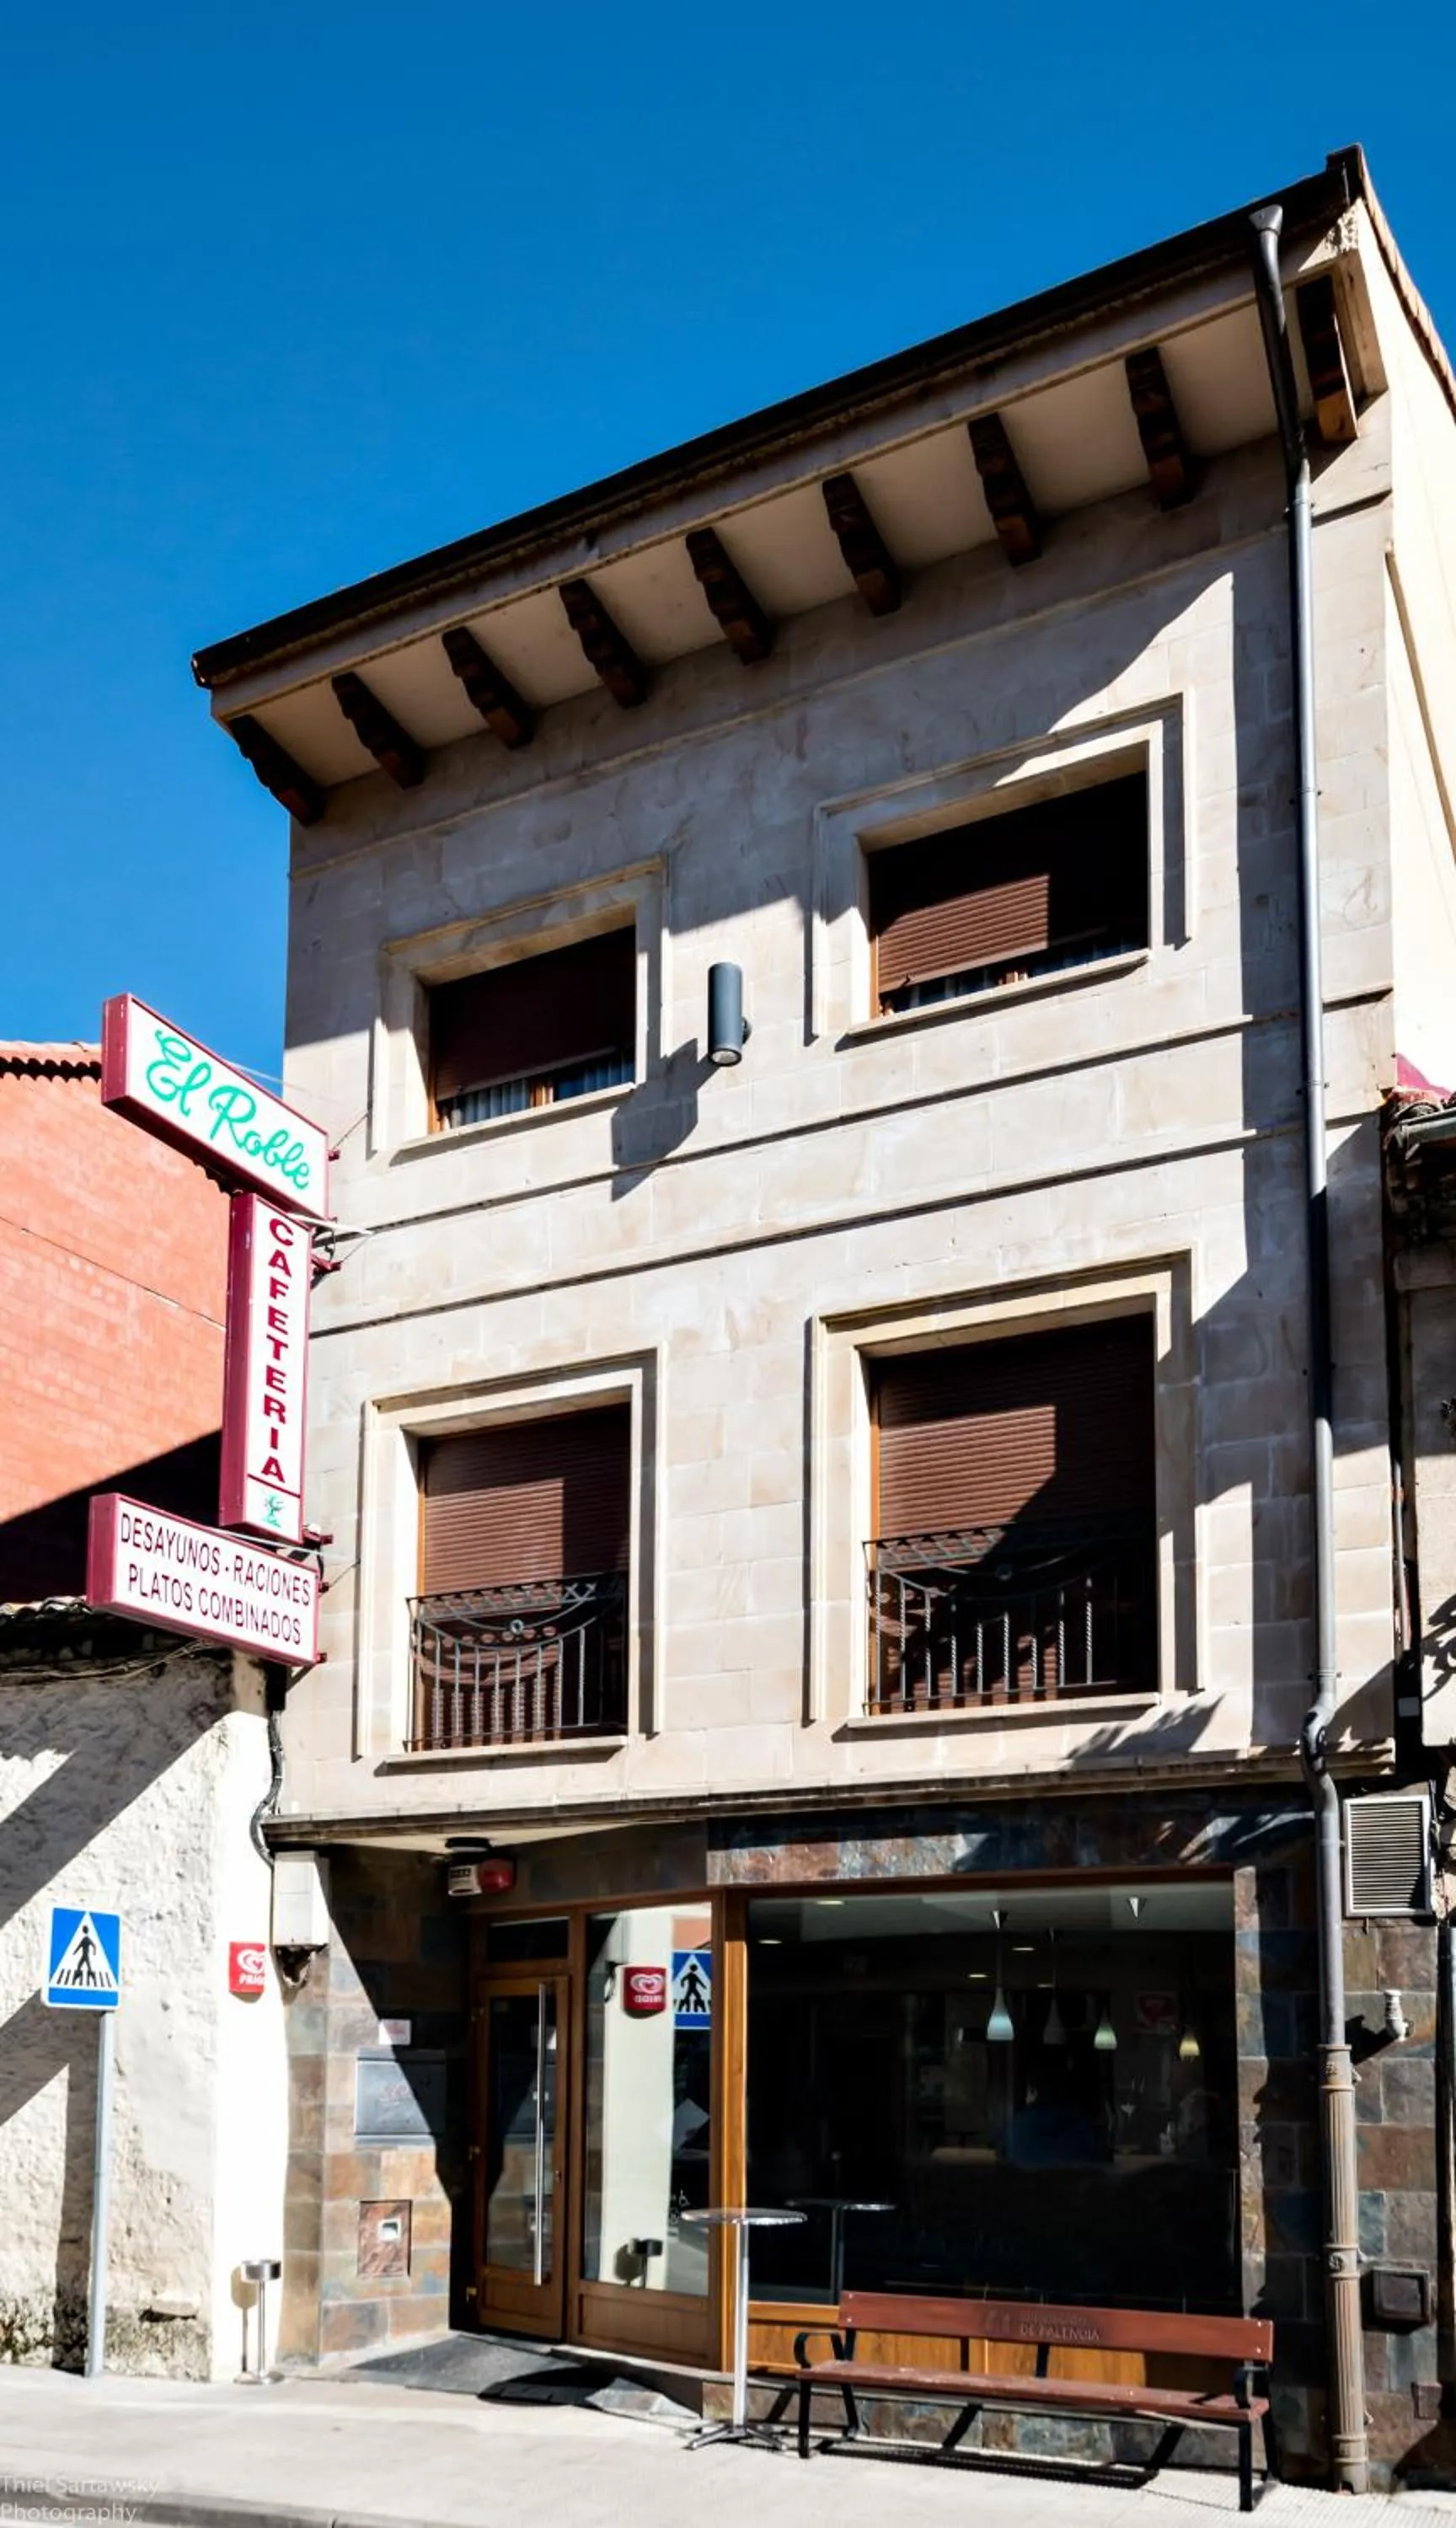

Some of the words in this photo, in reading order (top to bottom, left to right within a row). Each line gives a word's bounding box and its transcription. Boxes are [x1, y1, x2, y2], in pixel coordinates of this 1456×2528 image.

[147, 1029, 211, 1117] El
[208, 1085, 310, 1190] Roble
[261, 1217, 295, 1484] CAFETERIA
[120, 1513, 220, 1576] DESAYUNOS
[233, 1555, 311, 1606] RACIONES
[128, 1563, 193, 1611] PLATOS
[198, 1588, 301, 1645] COMBINADOS
